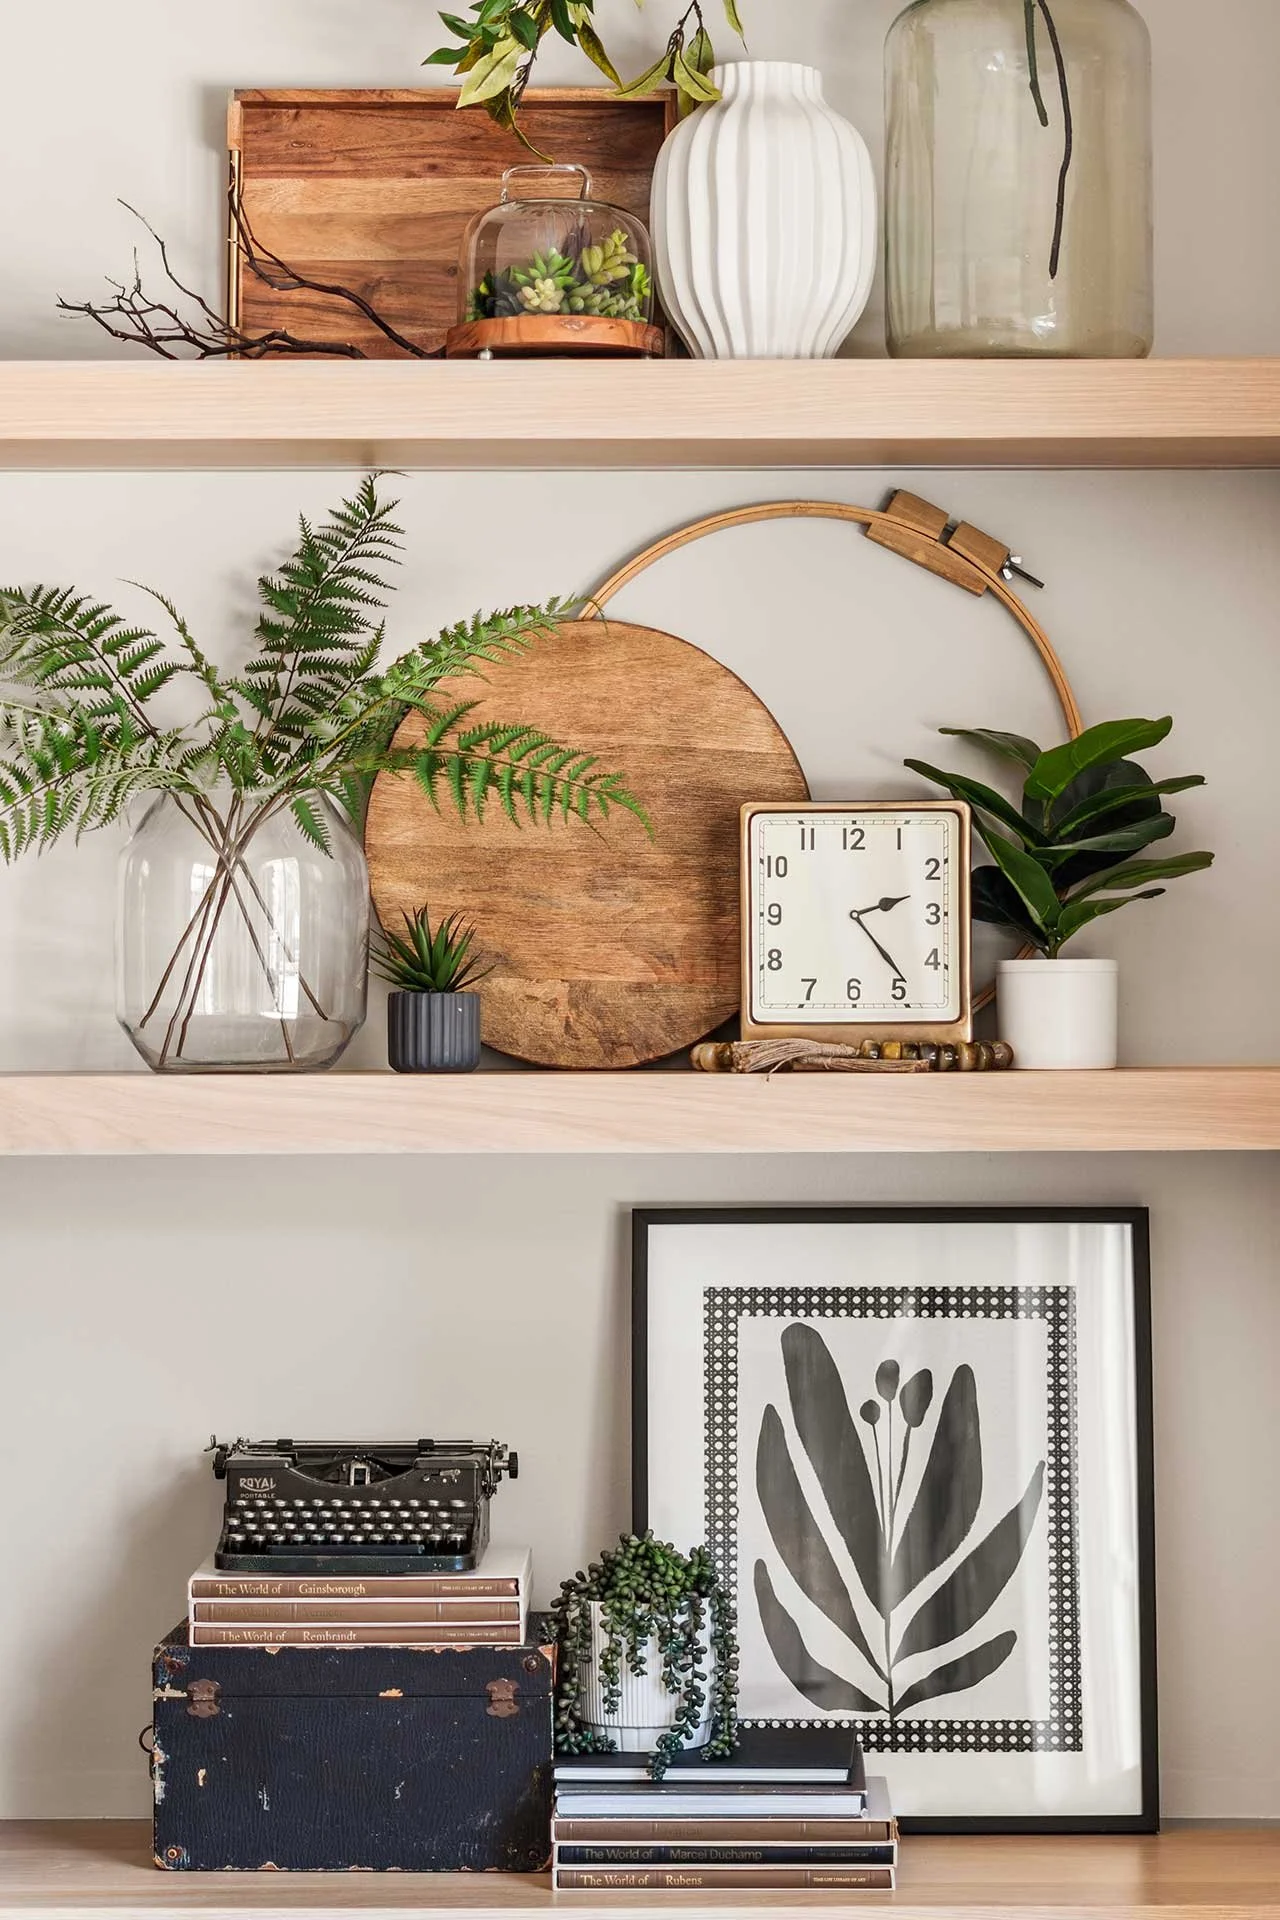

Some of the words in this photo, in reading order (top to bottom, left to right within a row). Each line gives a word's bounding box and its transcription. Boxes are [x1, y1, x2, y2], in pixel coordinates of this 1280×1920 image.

[801, 828, 815, 850] 11
[842, 828, 865, 850] 12
[897, 828, 901, 850] 1
[767, 856, 788, 877] 10
[925, 858, 941, 880] 2
[767, 903, 782, 925] 9
[925, 903, 941, 925] 3
[767, 949, 783, 971] 8
[924, 949, 941, 970] 4
[801, 979, 817, 1000] 7
[847, 978, 861, 1000] 6
[891, 978, 906, 1000] 5
[240, 1478, 277, 1492] ROYAL
[216, 1583, 239, 1595] The
[240, 1583, 270, 1595] World
[271, 1583, 283, 1595] of
[299, 1583, 366, 1598] Gainsborough
[220, 1631, 241, 1641] The
[242, 1631, 274, 1641] World
[275, 1631, 288, 1641] of
[303, 1631, 357, 1641] Rembrandt
[585, 1849, 604, 1860] The
[606, 1849, 639, 1860] World
[643, 1849, 654, 1860] of
[669, 1850, 707, 1860] Marcel
[710, 1850, 762, 1862] Duchamp
[580, 1875, 602, 1886] The
[604, 1875, 635, 1886] World
[638, 1875, 649, 1886] of
[665, 1875, 702, 1886] Rubens
